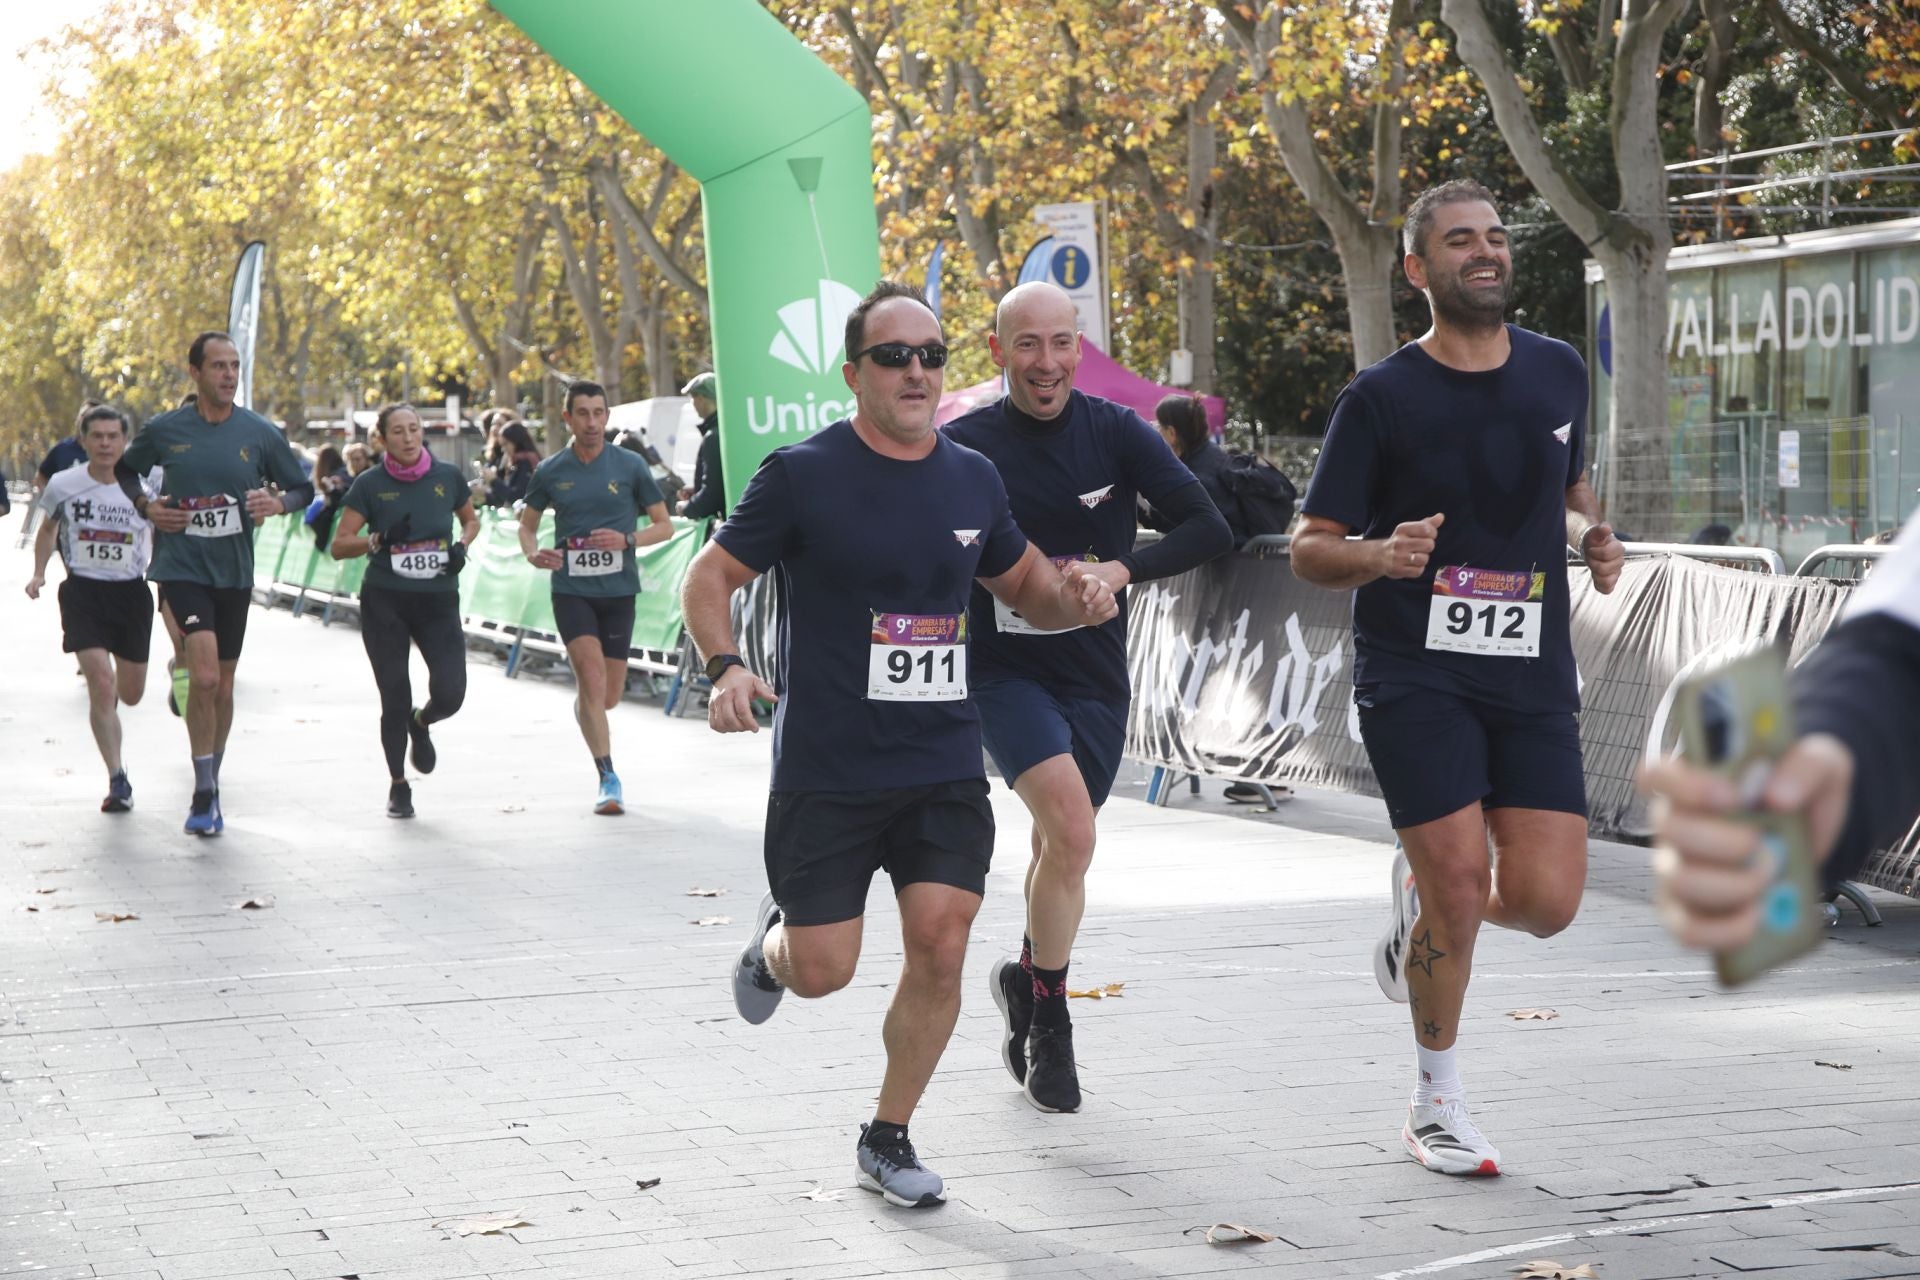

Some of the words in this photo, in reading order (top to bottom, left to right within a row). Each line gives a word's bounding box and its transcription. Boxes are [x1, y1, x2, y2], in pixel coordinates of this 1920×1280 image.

[97, 504, 135, 516] CUATRO
[101, 514, 130, 526] RAYAS
[191, 509, 229, 528] 487
[86, 544, 123, 561] 153
[575, 551, 613, 568] 489
[400, 554, 440, 571] 488
[1474, 573, 1505, 582] CARRERA
[1506, 574, 1515, 583] DE
[1473, 580, 1515, 592] EMPRESAS
[912, 618, 938, 626] CARRERA
[1446, 601, 1525, 639] 912
[911, 626, 946, 635] EMPRESAS
[887, 649, 954, 683] 911
